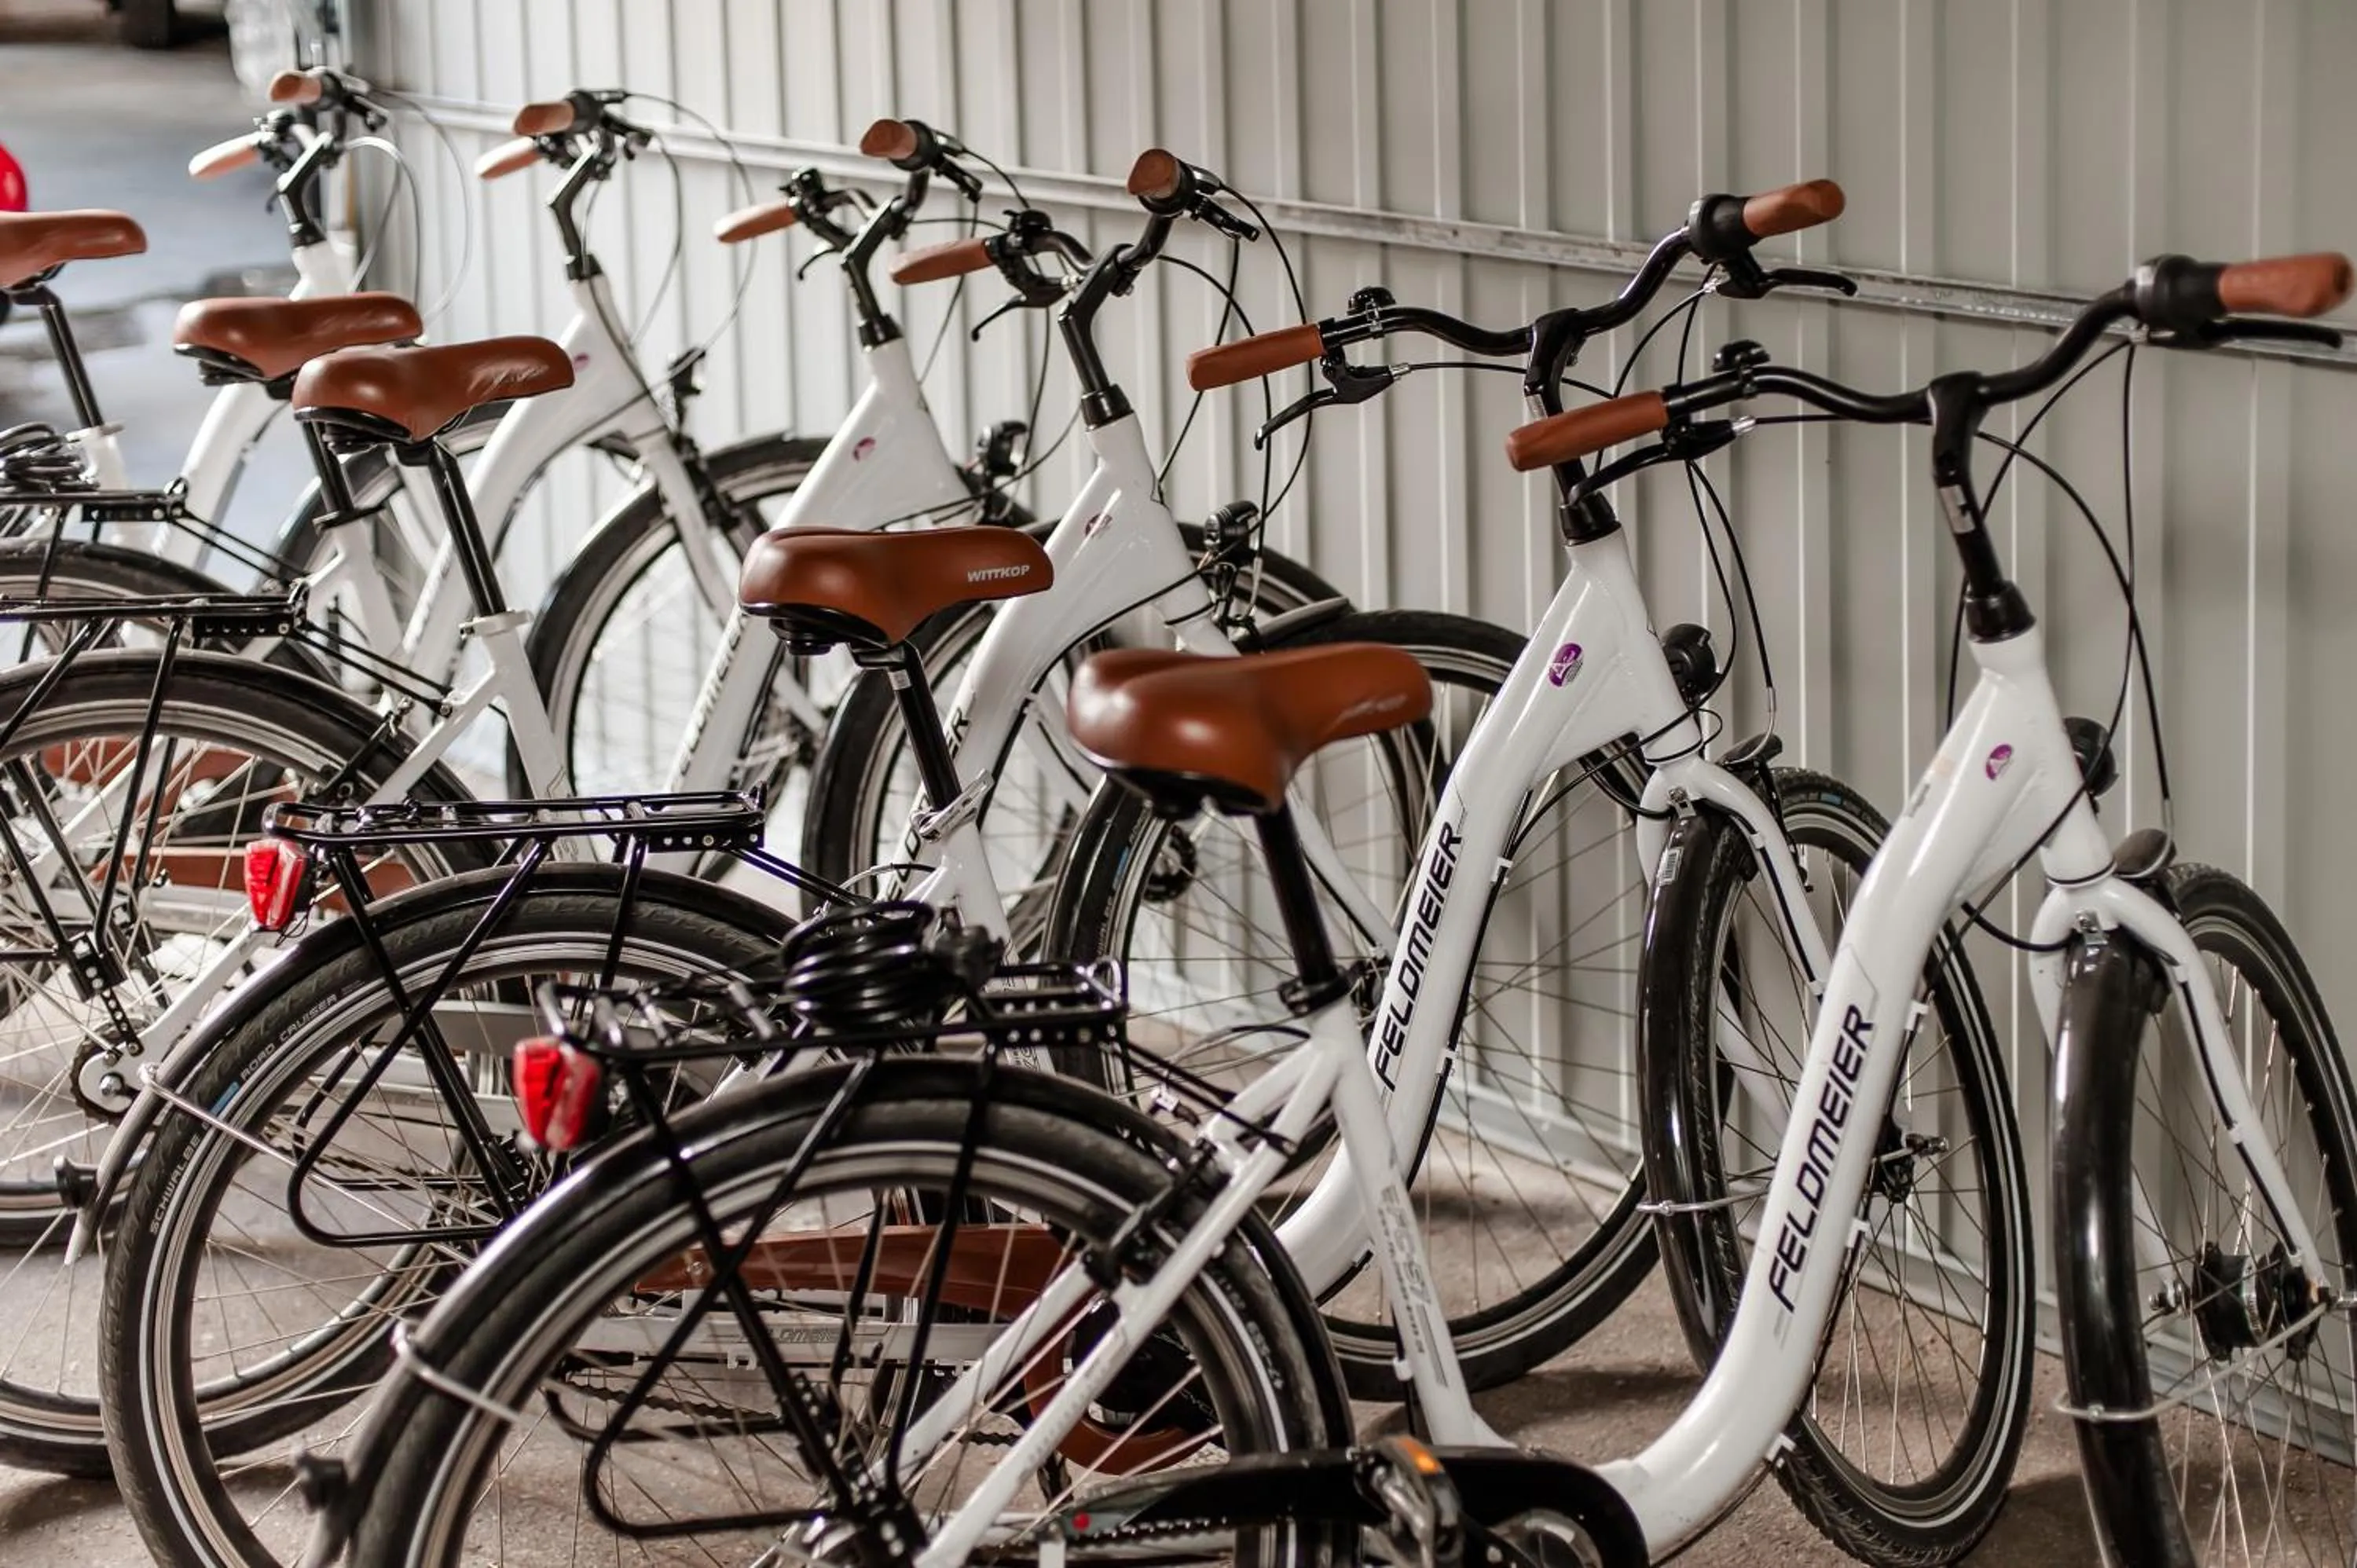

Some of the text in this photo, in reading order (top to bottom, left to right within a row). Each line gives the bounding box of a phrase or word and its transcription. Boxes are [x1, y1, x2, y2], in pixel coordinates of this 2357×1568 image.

[967, 565, 1031, 583] WITTKOP
[1375, 821, 1462, 1093] FELDMEIER
[149, 994, 339, 1235] SCHWALBE ROAD CRUISER
[1769, 1003, 1874, 1313] FELDMEIER
